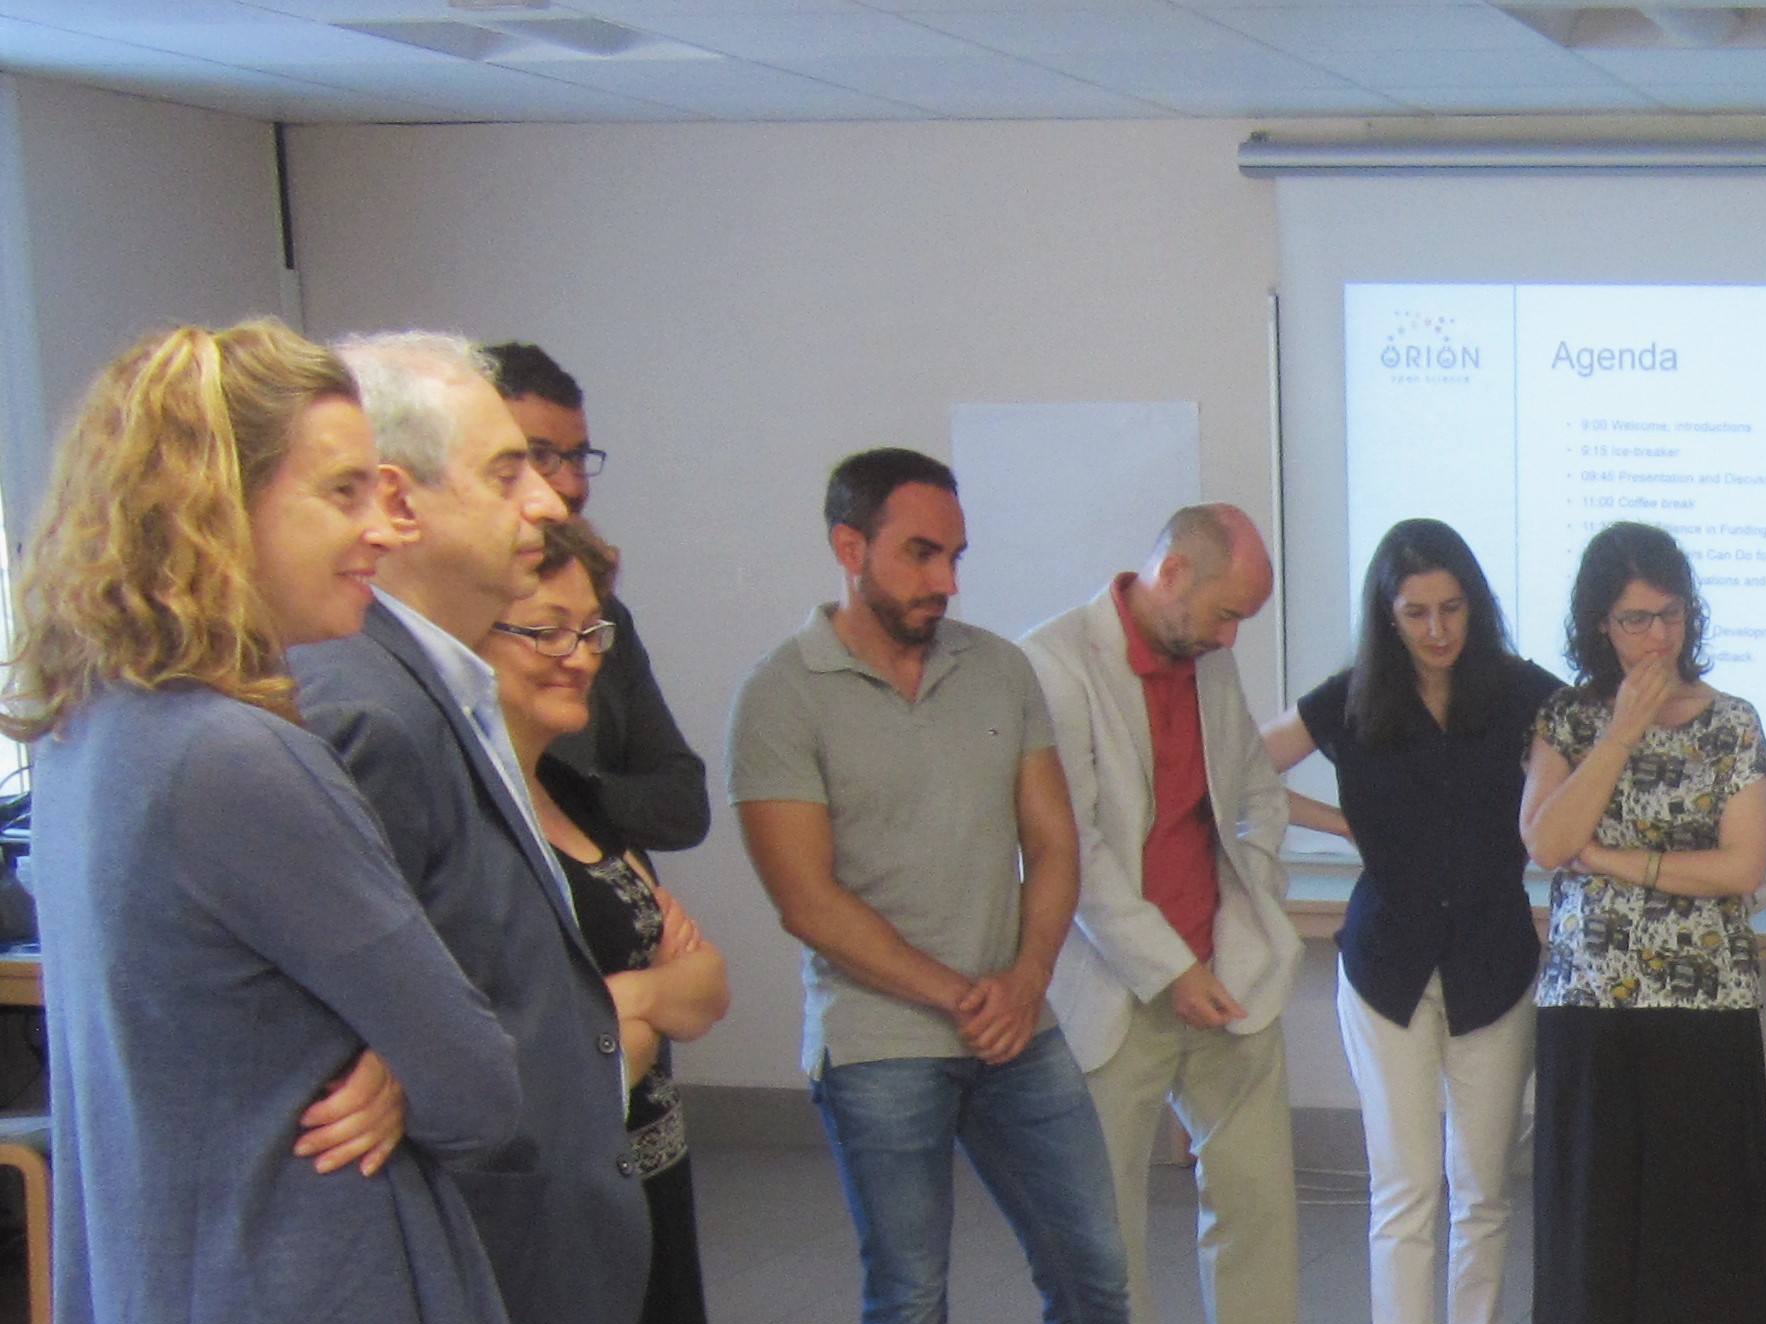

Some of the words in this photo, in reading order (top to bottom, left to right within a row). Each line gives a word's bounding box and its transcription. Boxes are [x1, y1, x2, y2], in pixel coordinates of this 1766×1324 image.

[1551, 340, 1679, 378] Agenda
[1580, 419, 1608, 432] 9:00
[1580, 444, 1608, 457] 9:15
[1618, 470, 1694, 484] Presentation
[1697, 472, 1721, 484] and
[1583, 496, 1614, 508] 11:00
[1617, 496, 1658, 509] Coffee
[1661, 497, 1696, 510] break
[1705, 523, 1717, 535] in
[1706, 548, 1732, 561] Can
[1735, 549, 1753, 561] Do
[1743, 576, 1766, 587] and
